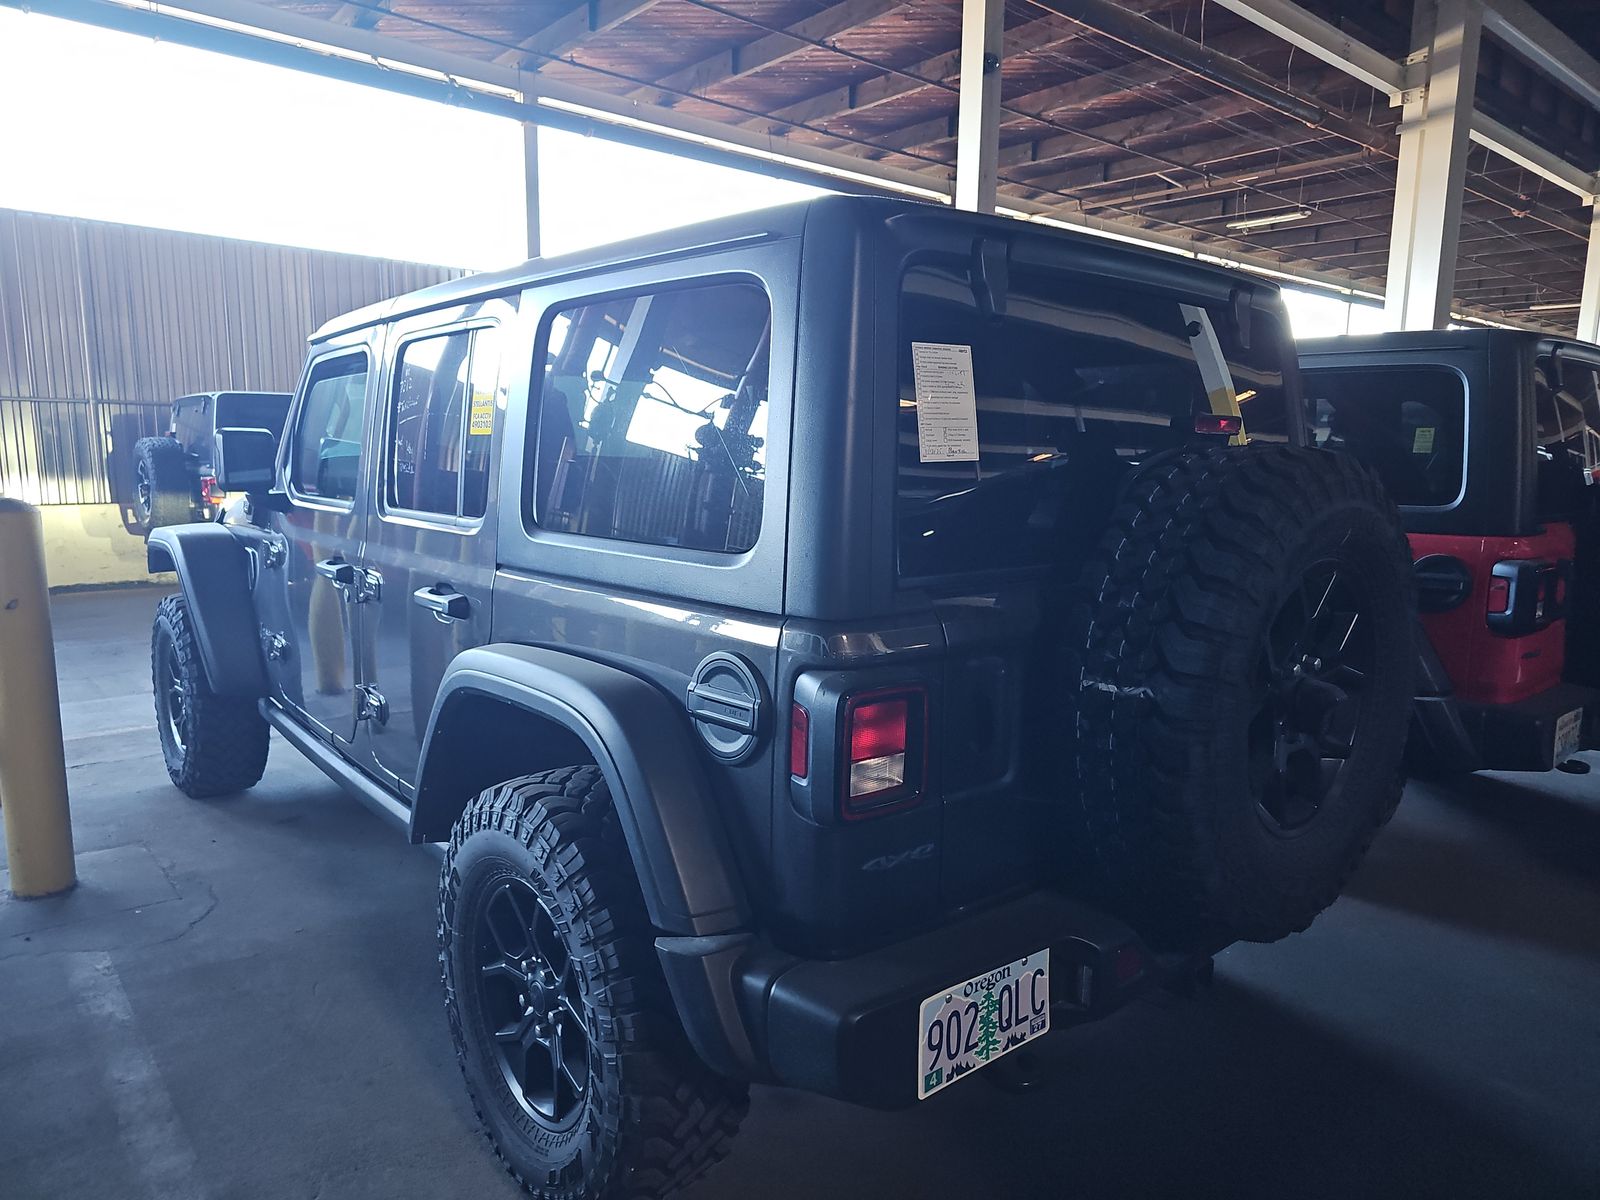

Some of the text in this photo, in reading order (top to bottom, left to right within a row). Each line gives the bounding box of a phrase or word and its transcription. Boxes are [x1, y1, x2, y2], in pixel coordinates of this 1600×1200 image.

[963, 965, 1012, 998] Oregon
[927, 968, 1046, 1071] 902 QLC
[929, 1073, 938, 1086] 4
